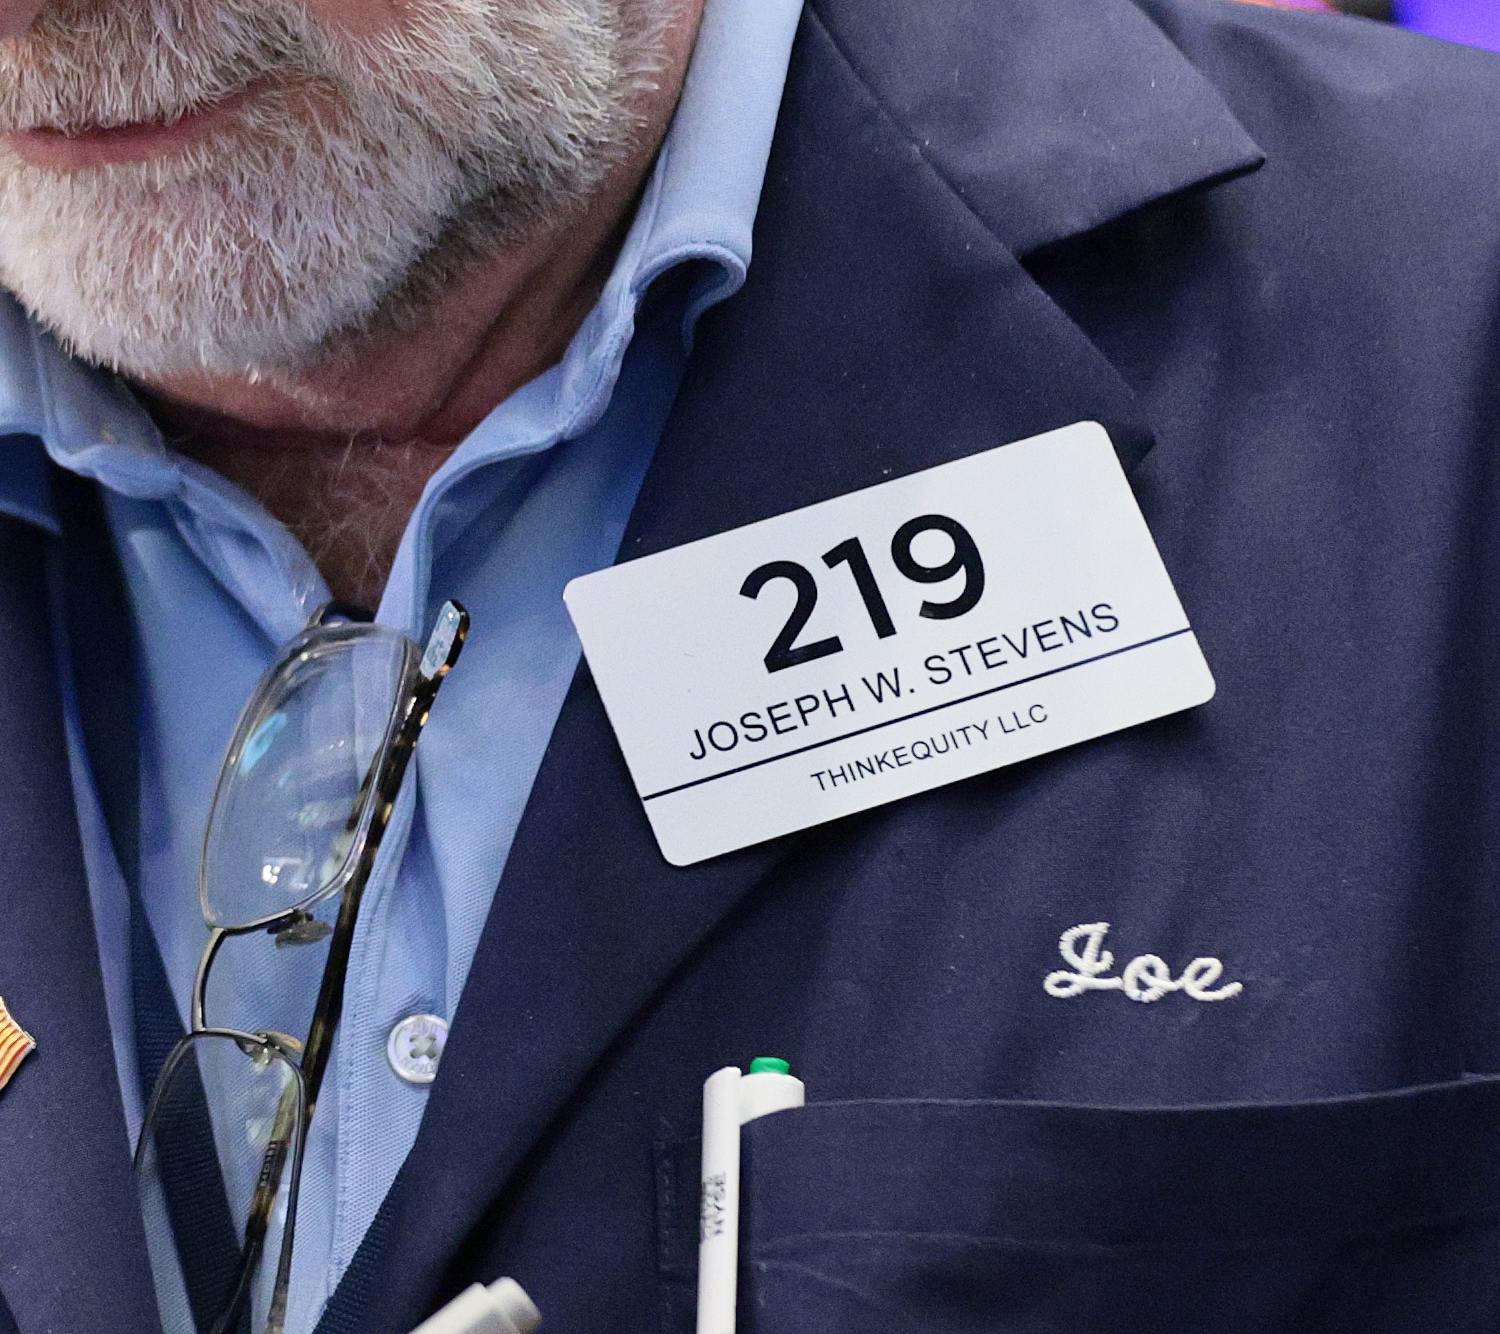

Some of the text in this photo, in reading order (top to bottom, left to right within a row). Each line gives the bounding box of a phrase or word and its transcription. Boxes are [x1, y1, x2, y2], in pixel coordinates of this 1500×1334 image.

[738, 514, 985, 674] 219
[689, 603, 1121, 761] JOSEPH W. STEVENS
[810, 703, 1049, 793] THINKEQUITY LLC
[1043, 922, 1243, 1003] Joe
